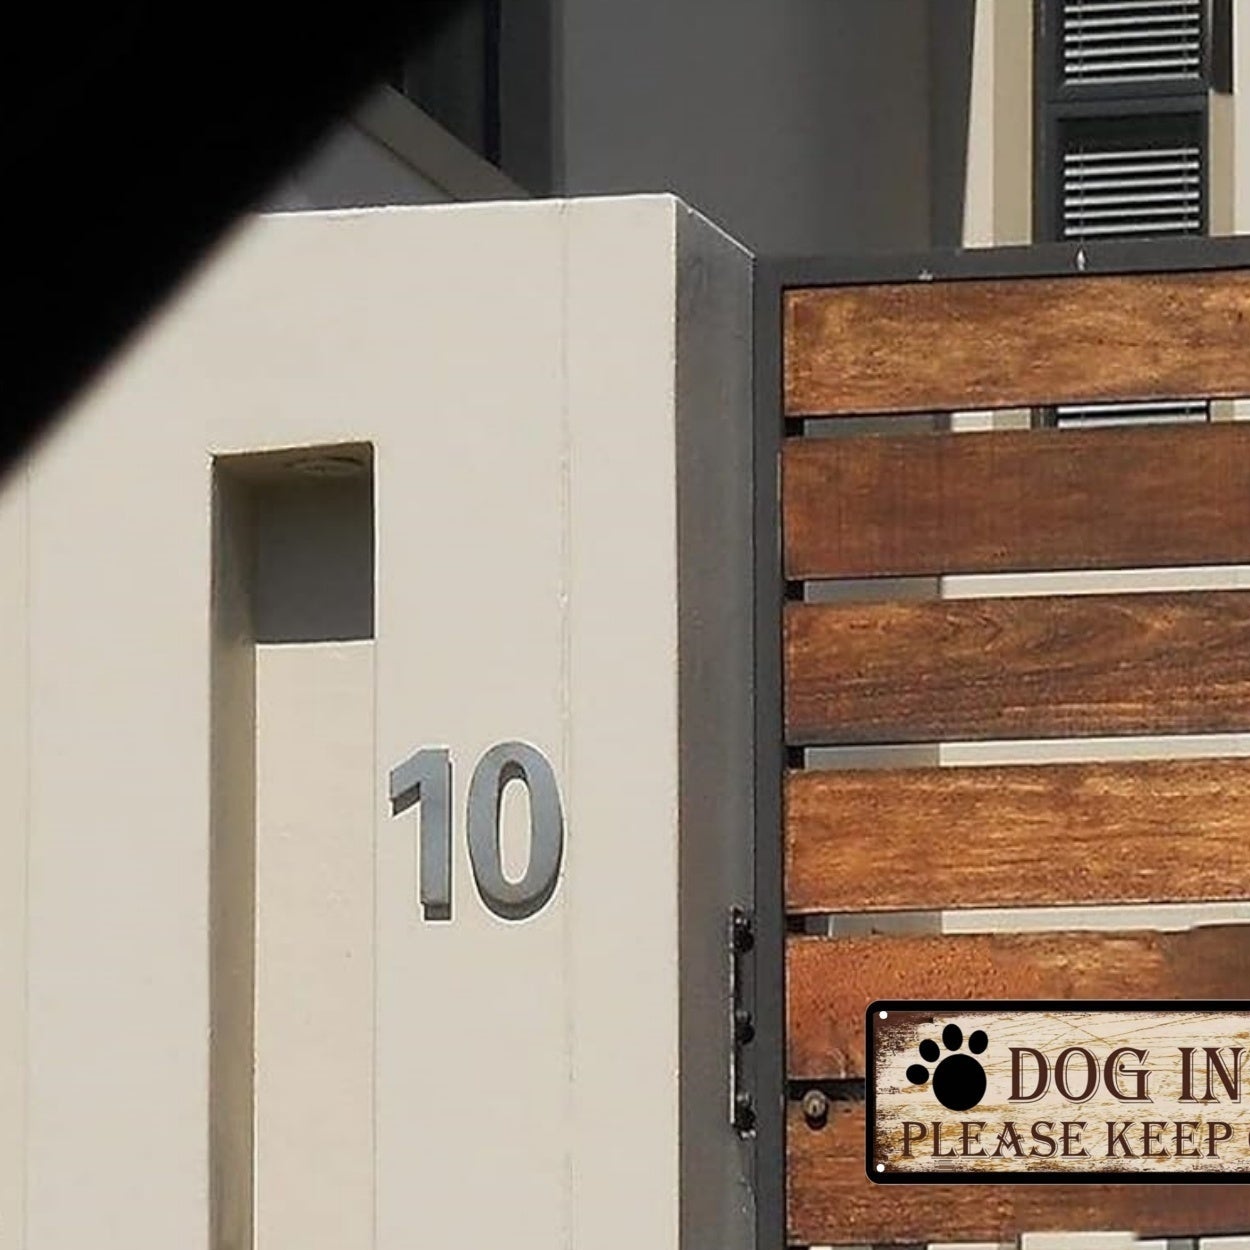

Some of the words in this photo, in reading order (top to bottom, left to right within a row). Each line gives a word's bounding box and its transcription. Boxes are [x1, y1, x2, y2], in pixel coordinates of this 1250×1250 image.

[389, 741, 564, 921] 10
[1008, 1046, 1152, 1104] DOG
[1178, 1046, 1245, 1104] IN
[901, 1120, 1090, 1161] PLEASE
[1105, 1120, 1234, 1161] KEEP
